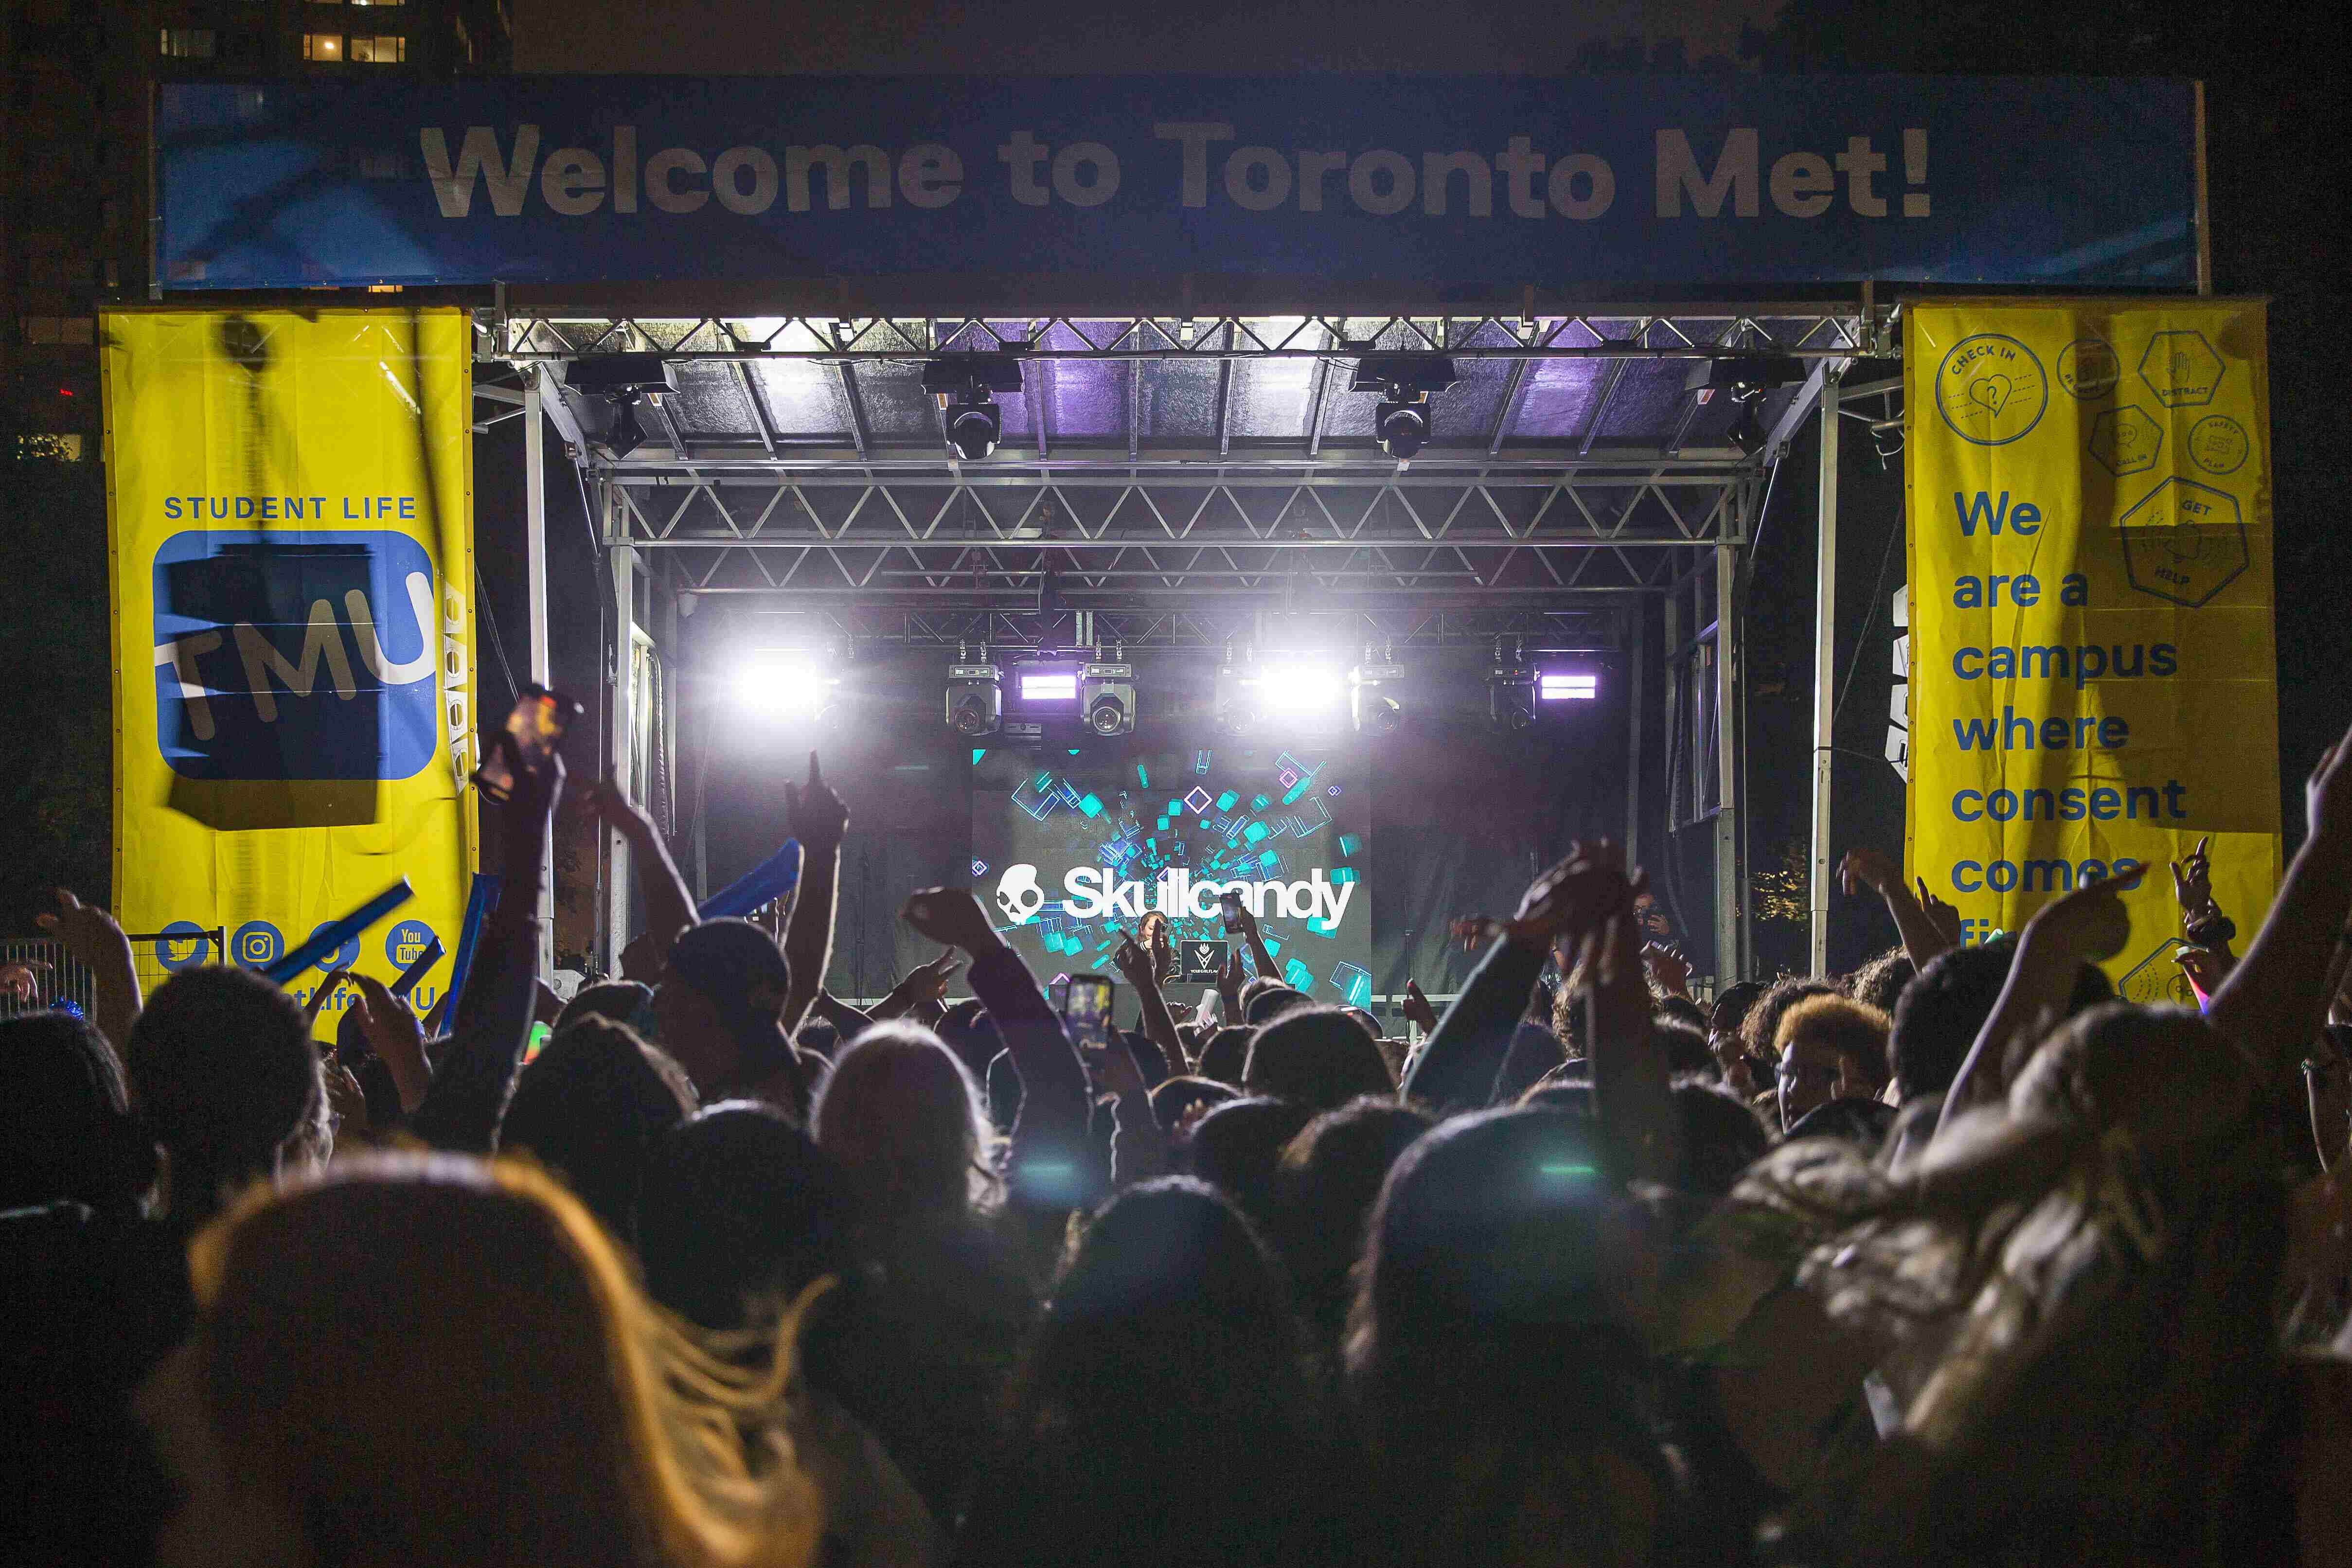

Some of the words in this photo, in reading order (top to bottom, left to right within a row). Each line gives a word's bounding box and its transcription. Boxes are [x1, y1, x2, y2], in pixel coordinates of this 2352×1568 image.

[419, 125, 965, 218] Welcome
[997, 130, 1122, 207] to
[1153, 121, 1616, 221] Toronto
[1655, 127, 1931, 218] Met!
[1952, 345, 1995, 374] CHECK
[1999, 347, 2016, 362] IN
[164, 497, 327, 519] STUDENT
[343, 497, 416, 519] LIFE
[1953, 490, 2041, 537] We
[2182, 499, 2212, 515] GET
[1953, 574, 2041, 608] are
[2061, 573, 2088, 607] a
[154, 571, 436, 740] TMU
[1952, 642, 2178, 690] campus
[1952, 705, 2129, 751] where
[1951, 779, 2188, 822] consent
[1951, 858, 2142, 893] comes
[1062, 866, 1355, 930] Skullcandy
[401, 928, 420, 943] You
